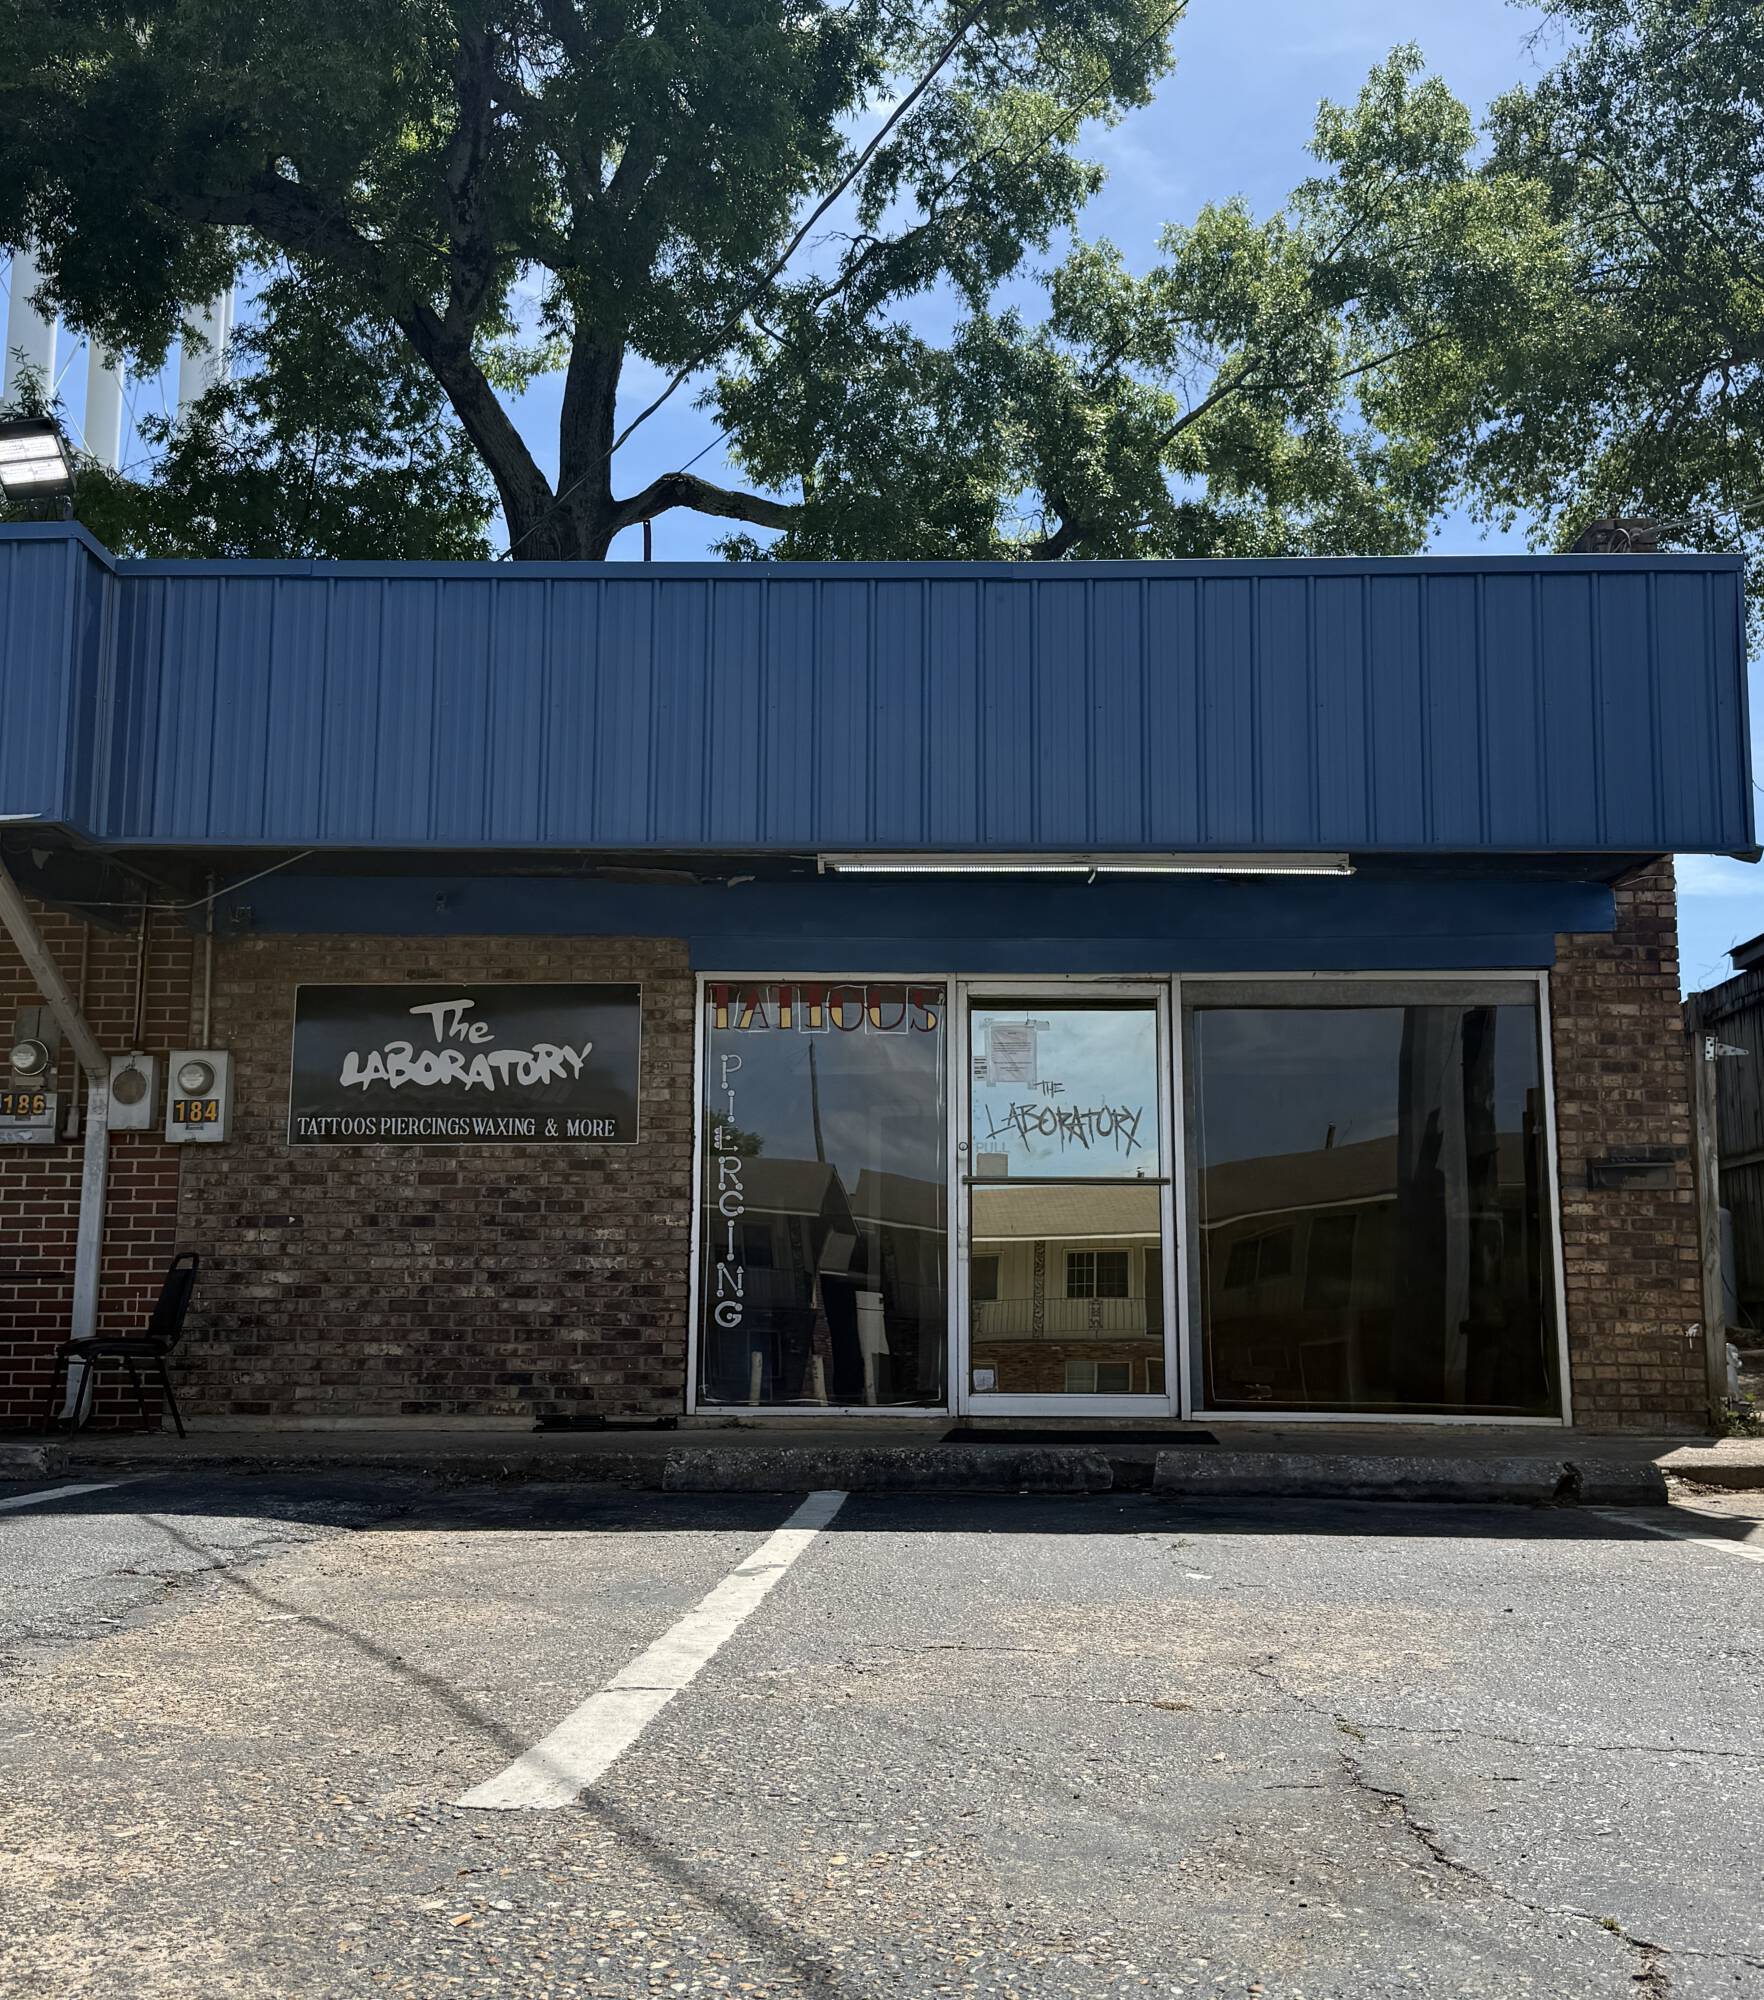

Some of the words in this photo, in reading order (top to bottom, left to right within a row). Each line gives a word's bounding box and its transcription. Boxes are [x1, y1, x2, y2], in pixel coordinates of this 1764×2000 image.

[409, 998, 495, 1044] The
[339, 1040, 593, 1092] LABORATORY
[1034, 1080, 1065, 1099] THE
[3, 1094, 46, 1115] 186
[175, 1101, 217, 1122] 184
[297, 1116, 377, 1136] TATTOOS
[379, 1116, 470, 1136] PIERCINGS
[472, 1117, 536, 1137] WAXING
[544, 1118, 559, 1137] &
[566, 1119, 616, 1138] MORE
[985, 1102, 1143, 1158] LABORATORY
[975, 1142, 1010, 1153] PULL
[713, 1053, 744, 1329] PIERCING
